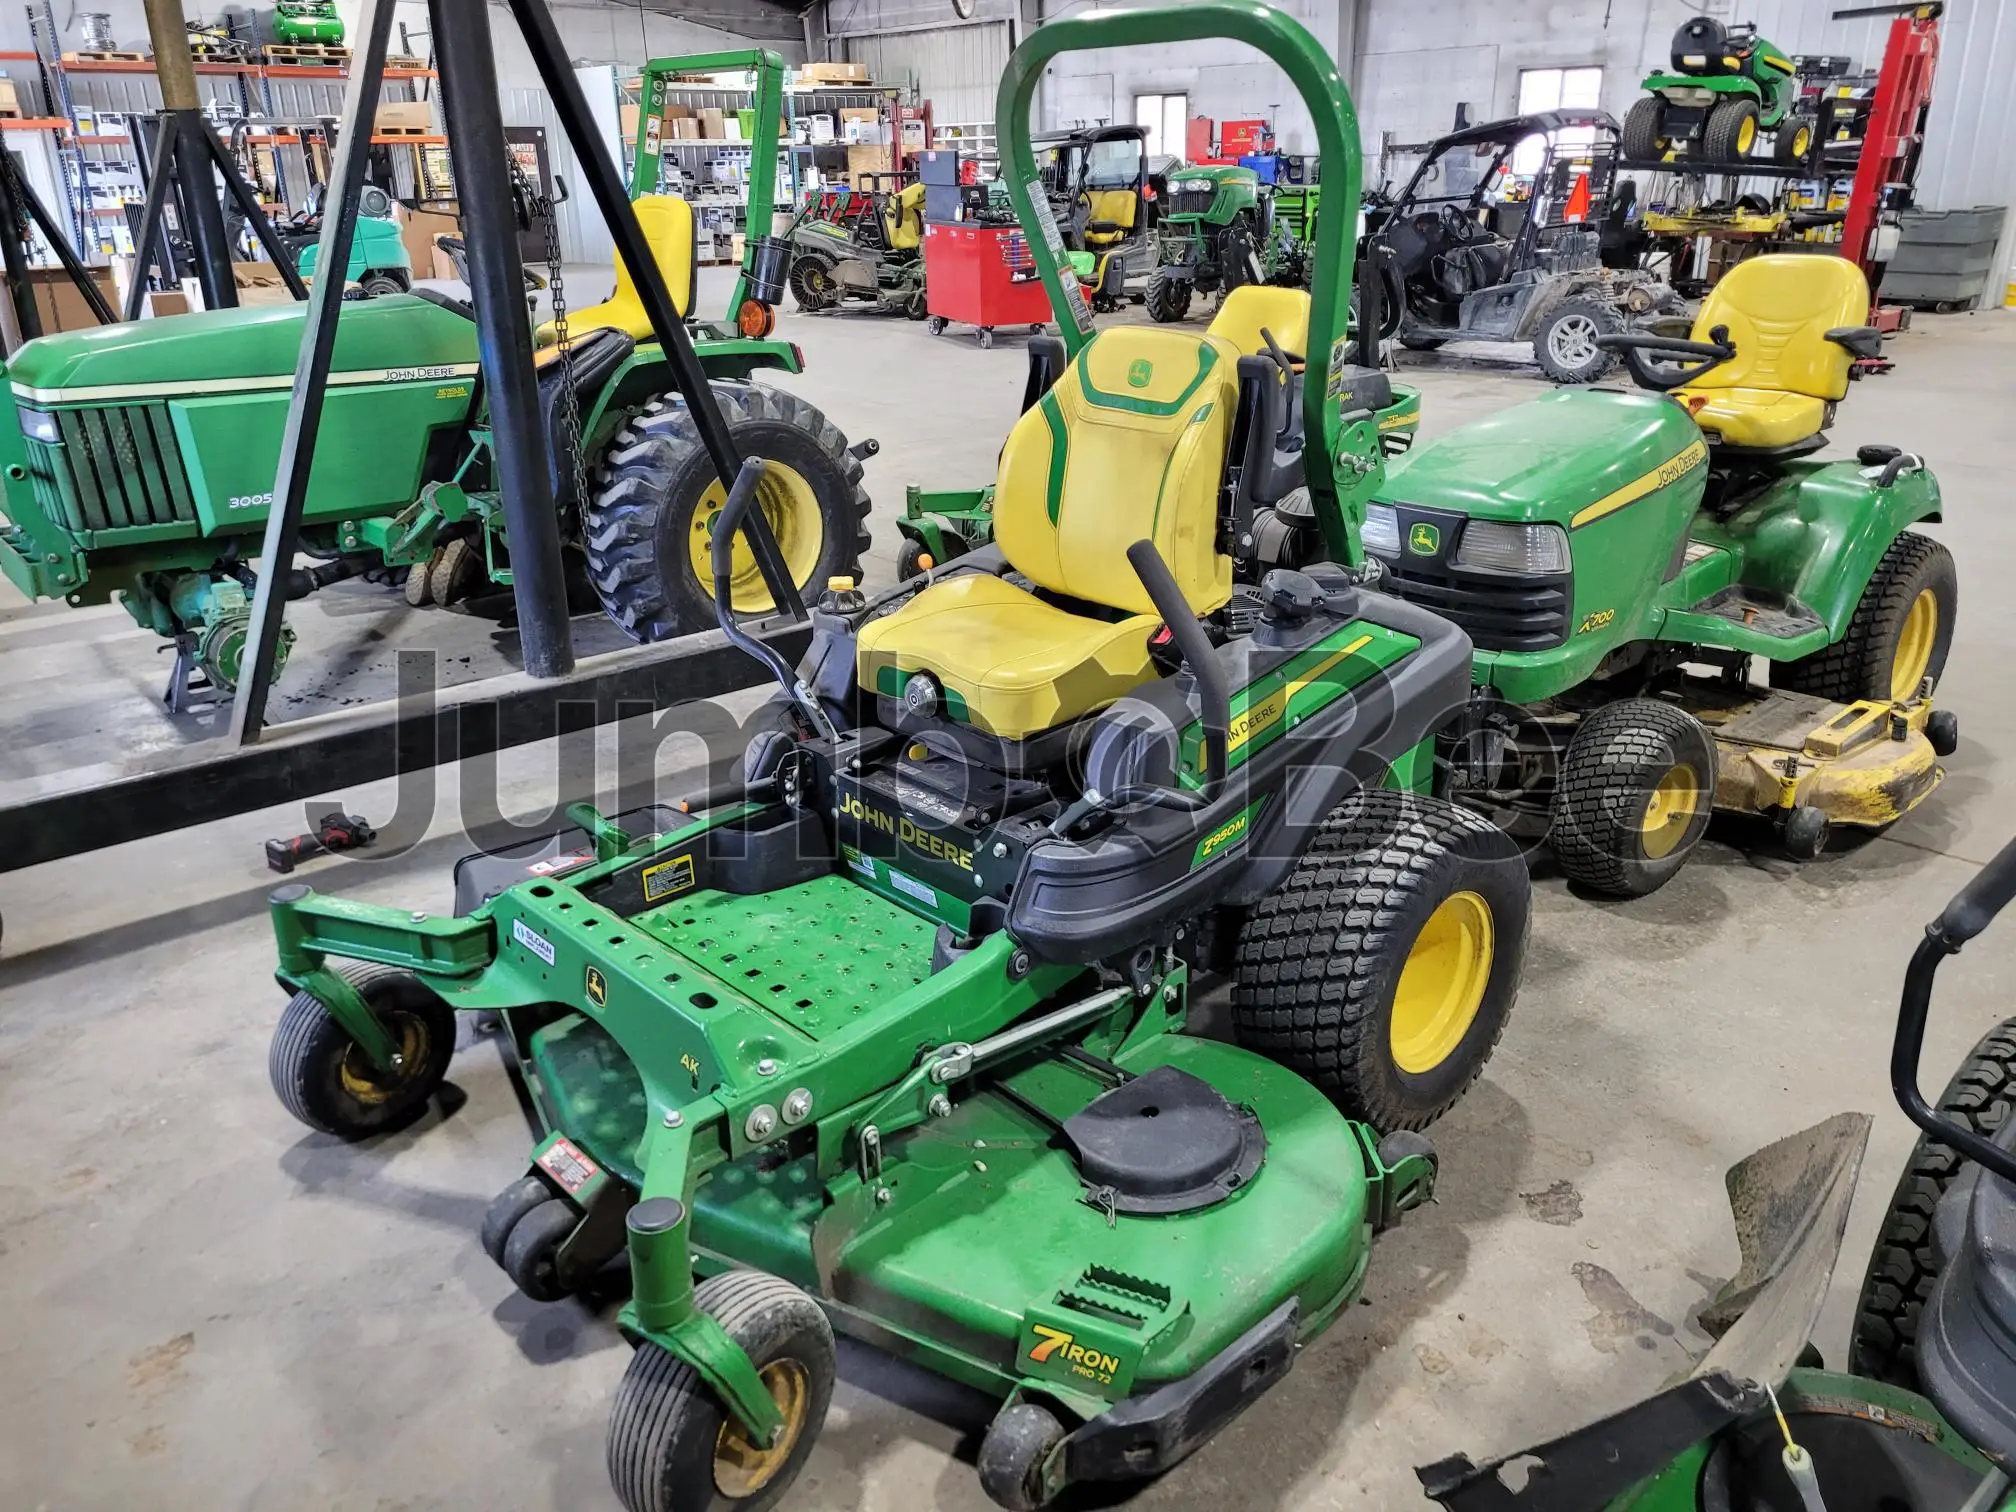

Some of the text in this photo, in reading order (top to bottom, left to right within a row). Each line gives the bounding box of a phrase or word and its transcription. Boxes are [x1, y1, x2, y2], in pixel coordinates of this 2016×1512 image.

[384, 367, 455, 381] JOHN DEERE
[1657, 448, 1699, 486] JOHN DEERE
[229, 493, 273, 508] 3005
[1239, 703, 1277, 734] DEERE
[839, 791, 895, 836] JOHN
[899, 816, 975, 873] DEERE
[1202, 816, 1247, 856] Z950M
[1071, 1364, 1112, 1385] PRO 72
